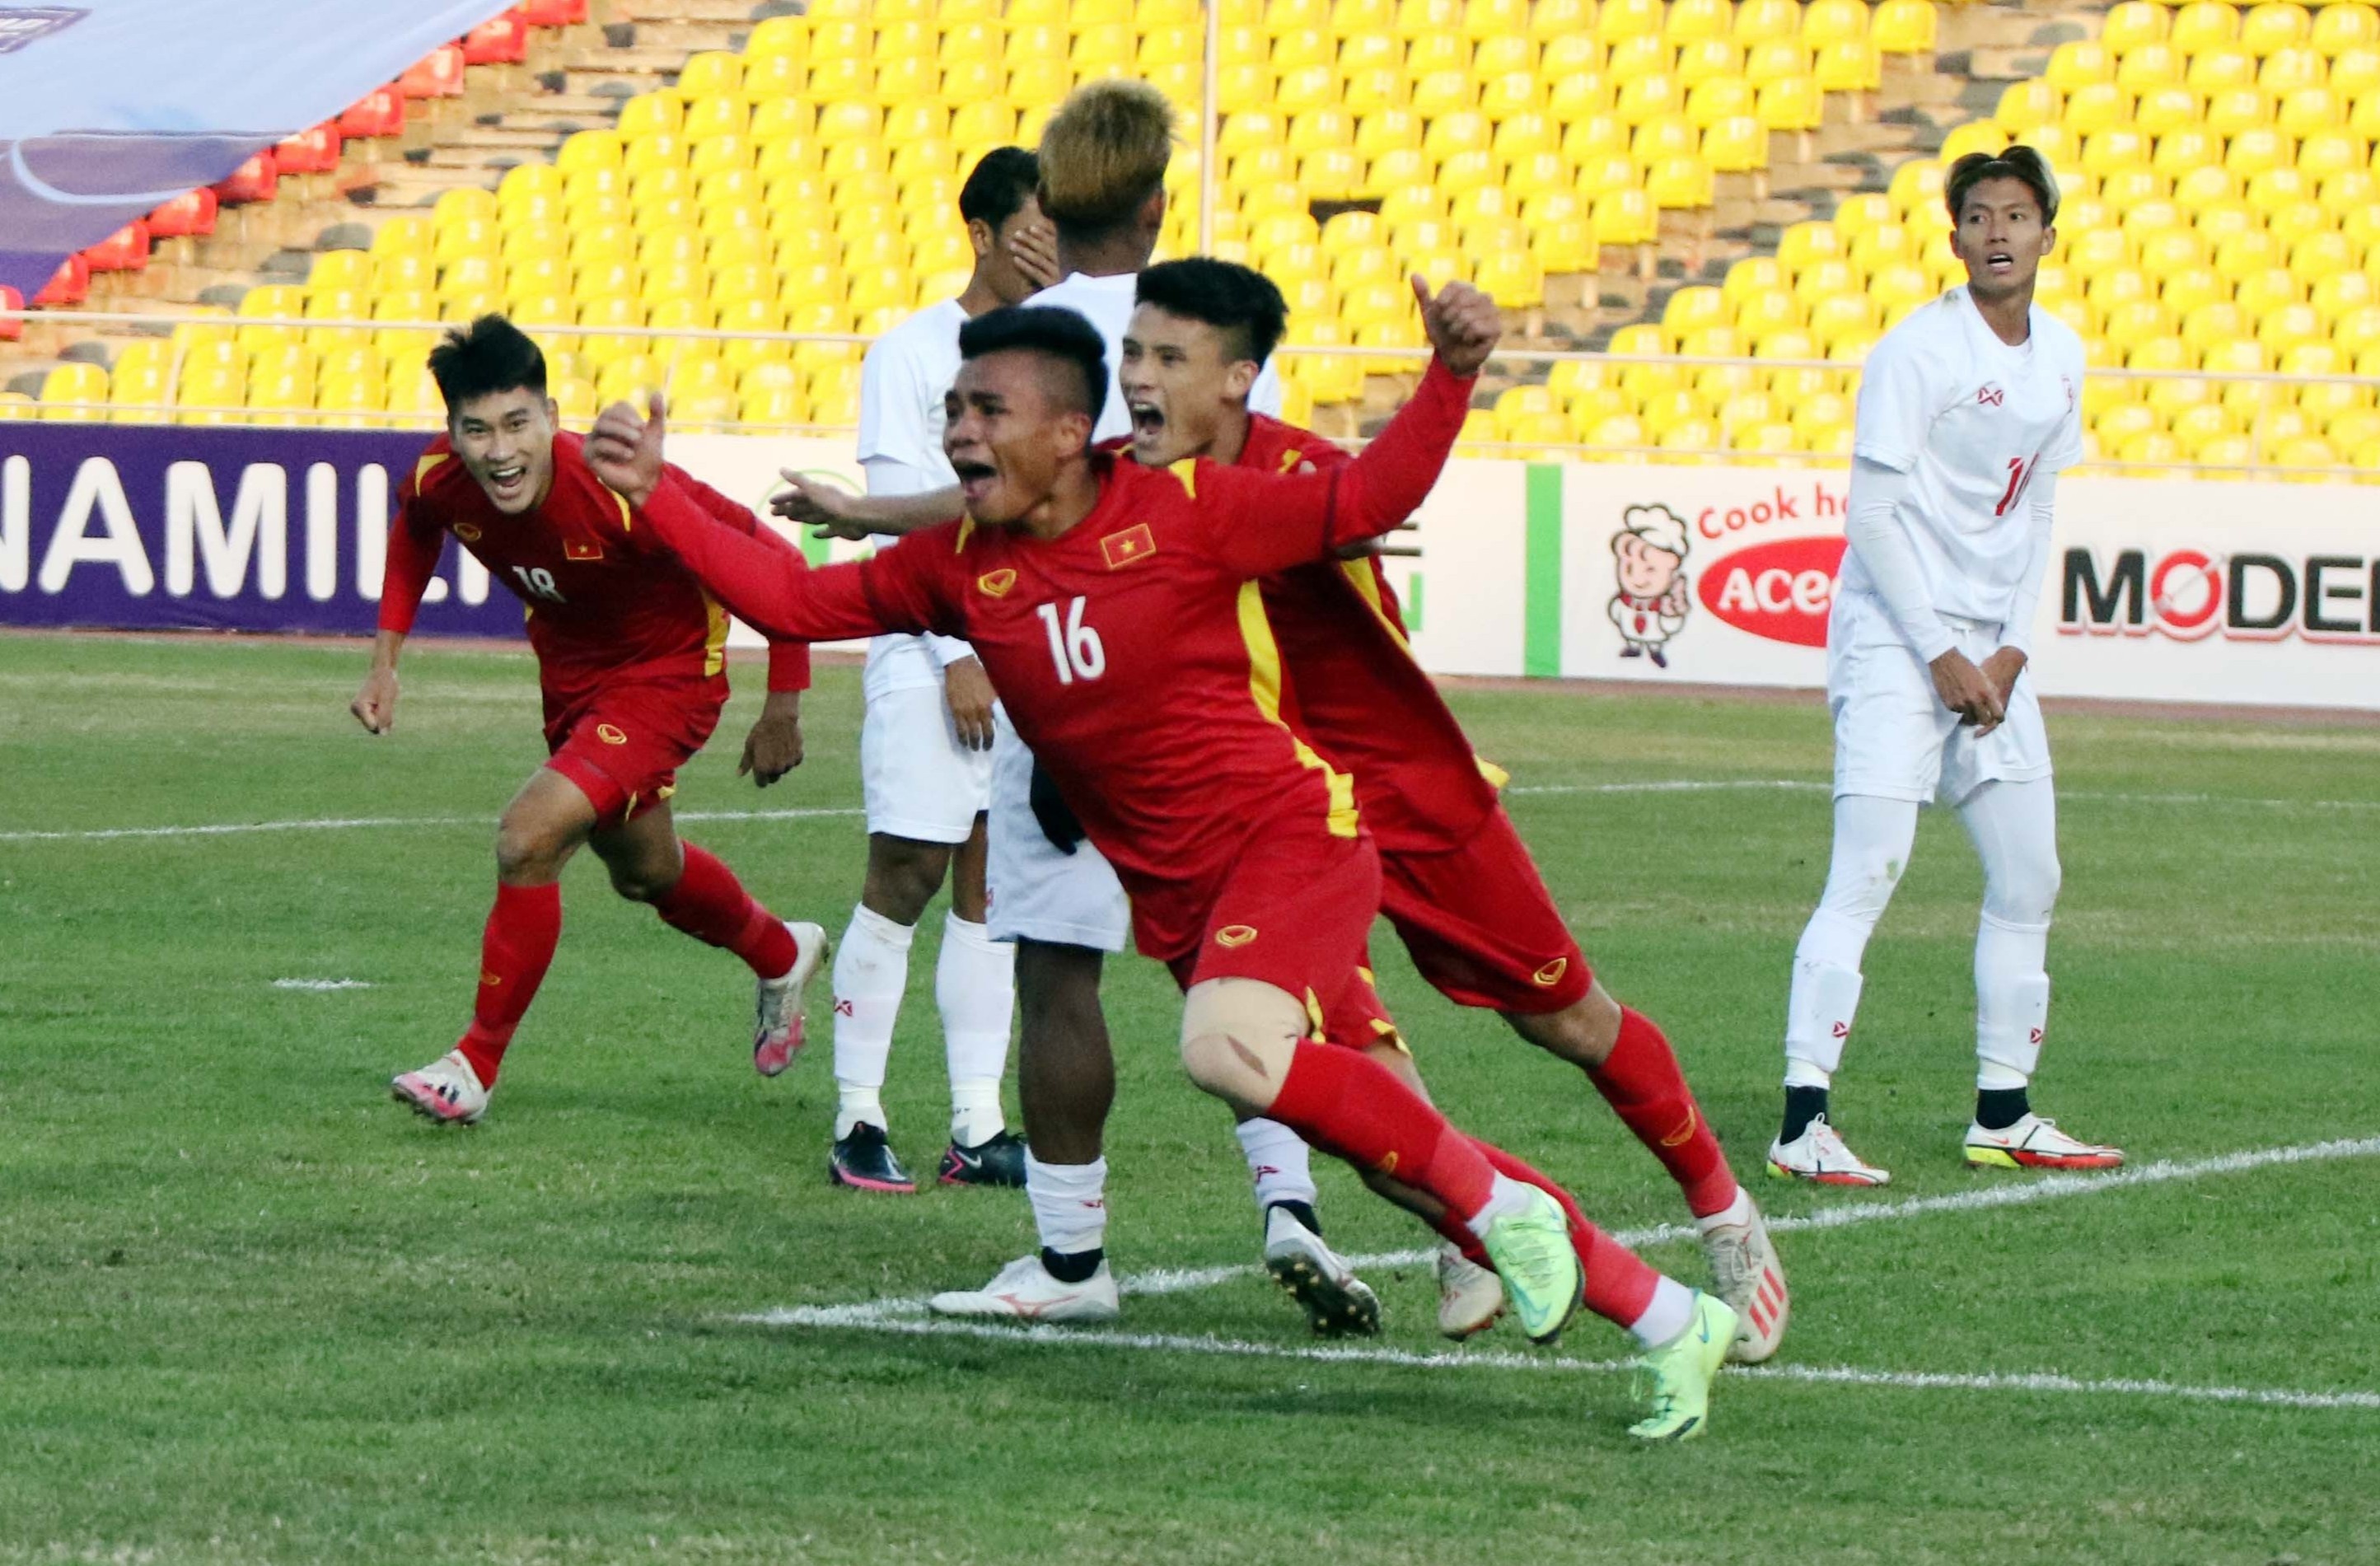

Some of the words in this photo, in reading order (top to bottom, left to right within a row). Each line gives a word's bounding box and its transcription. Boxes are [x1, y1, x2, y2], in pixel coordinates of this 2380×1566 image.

[1699, 484, 1799, 540] Cook
[2061, 547, 2380, 633] MODE
[1036, 596, 1106, 685] 16
